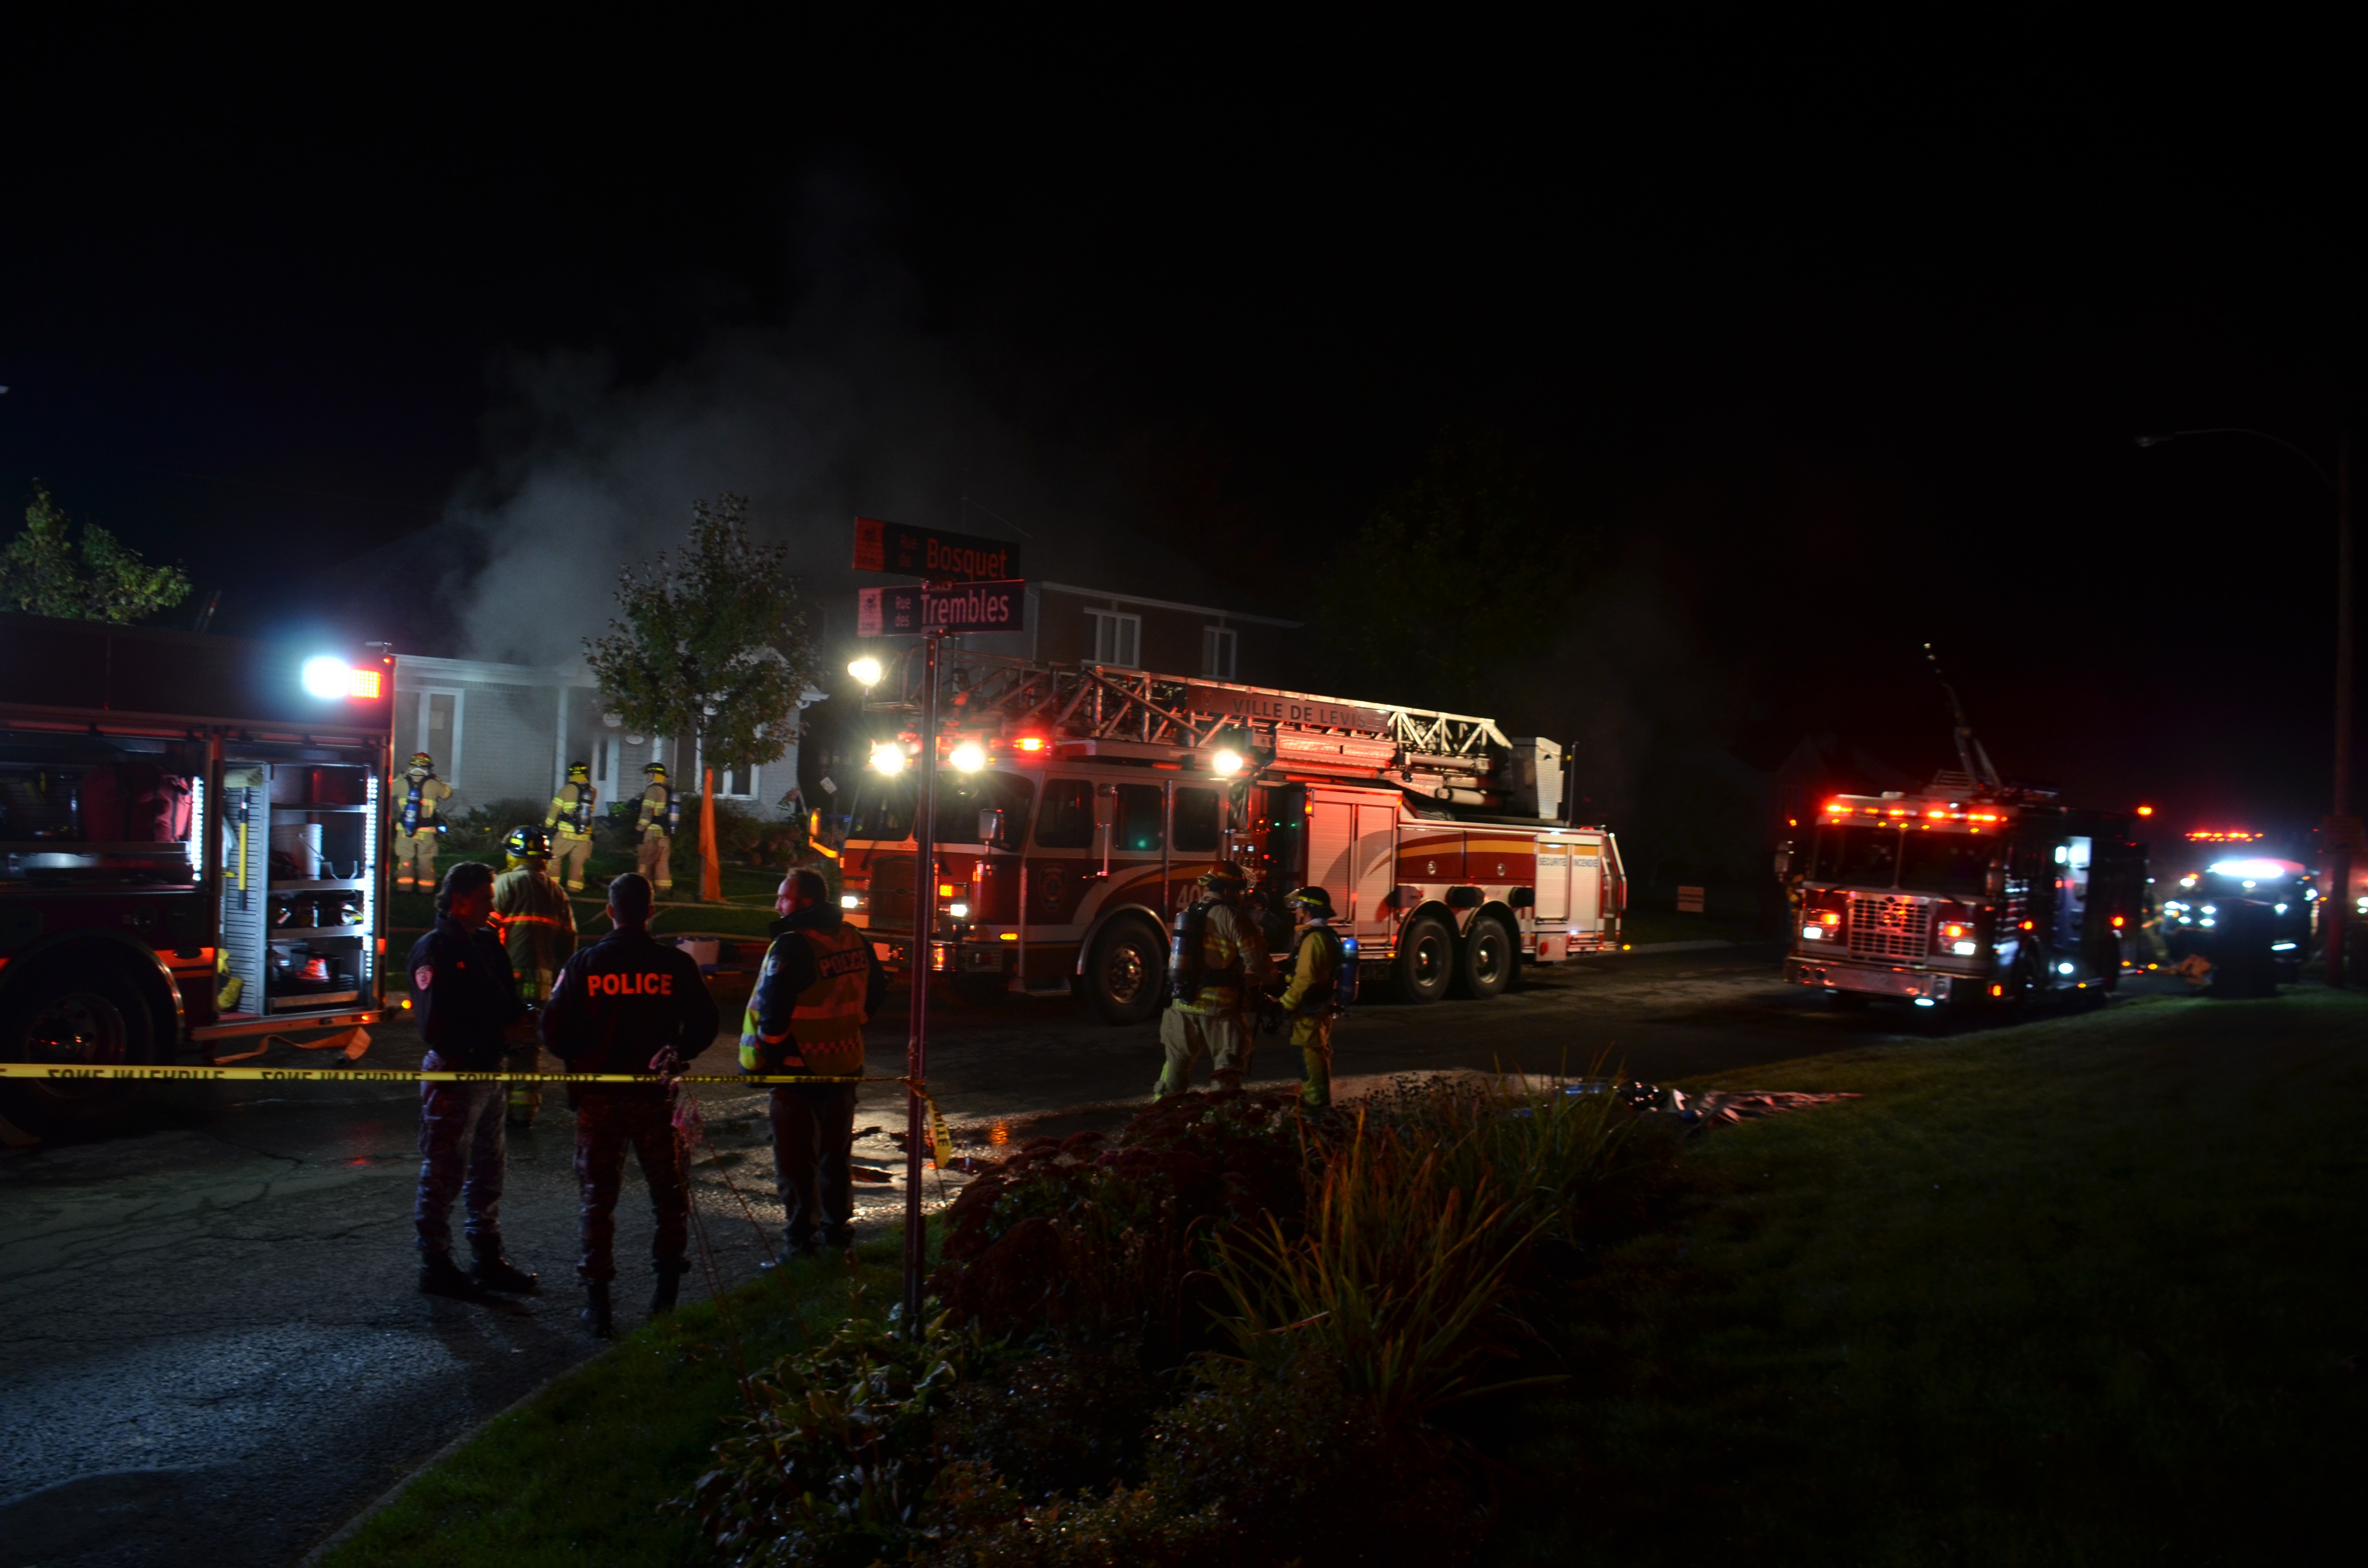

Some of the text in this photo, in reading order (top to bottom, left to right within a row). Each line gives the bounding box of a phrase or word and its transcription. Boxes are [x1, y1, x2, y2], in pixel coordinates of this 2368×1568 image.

[899, 533, 918, 550] Rue
[899, 552, 912, 567] du
[926, 538, 1008, 582] Bosquet
[895, 596, 911, 610] Rue
[920, 588, 1009, 624] Trembles
[895, 613, 910, 627] des
[1233, 698, 1366, 729] VILLE DE LÉVIS
[587, 972, 673, 997] POLICE
